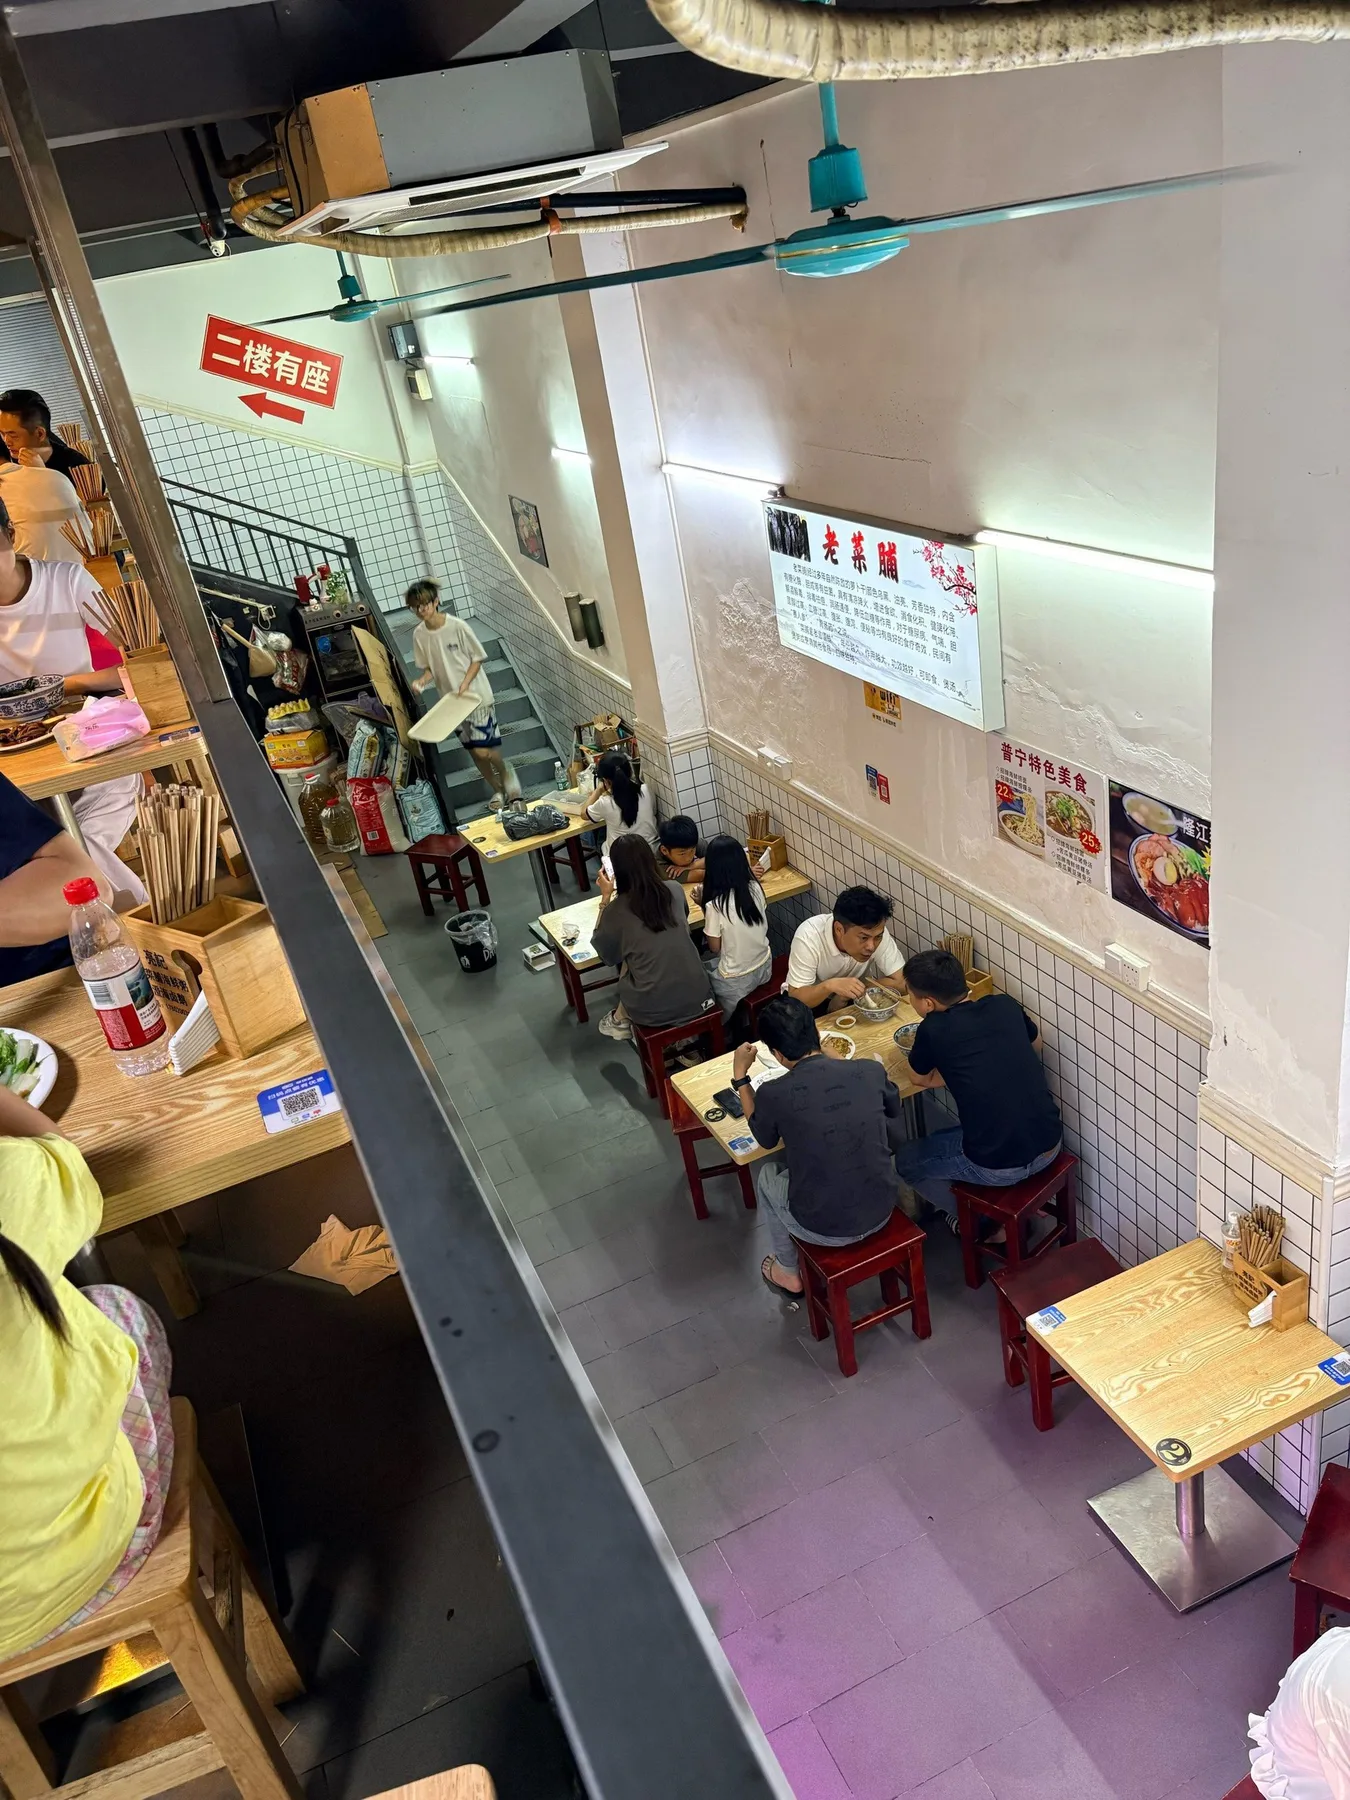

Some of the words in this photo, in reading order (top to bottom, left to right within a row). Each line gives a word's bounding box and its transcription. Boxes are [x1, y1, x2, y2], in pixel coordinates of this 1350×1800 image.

[212, 333, 332, 395] 二楼有座
[822, 523, 900, 584] 老菜脯
[1001, 742, 1087, 795] 普宁特色美食
[1182, 815, 1211, 844] 隆江
